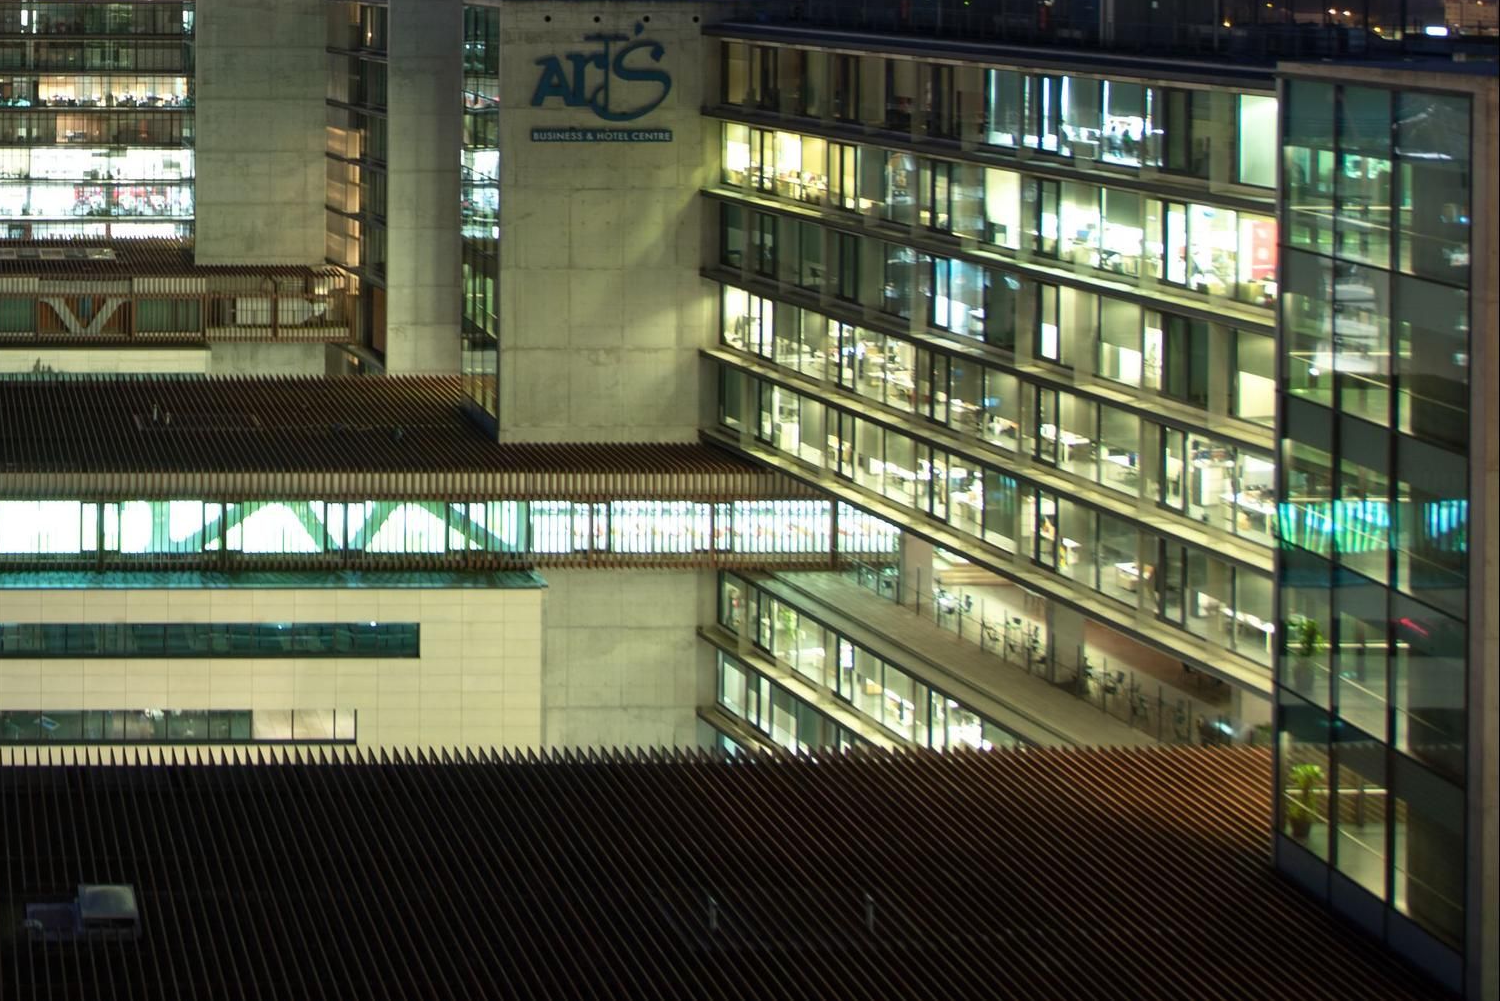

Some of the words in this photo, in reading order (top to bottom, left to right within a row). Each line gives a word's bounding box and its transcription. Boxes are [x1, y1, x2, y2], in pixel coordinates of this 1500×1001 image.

[532, 131, 583, 141] BUSINESS
[585, 131, 595, 141] &
[596, 131, 629, 141] HOTEL
[631, 131, 671, 141] CENTRE
